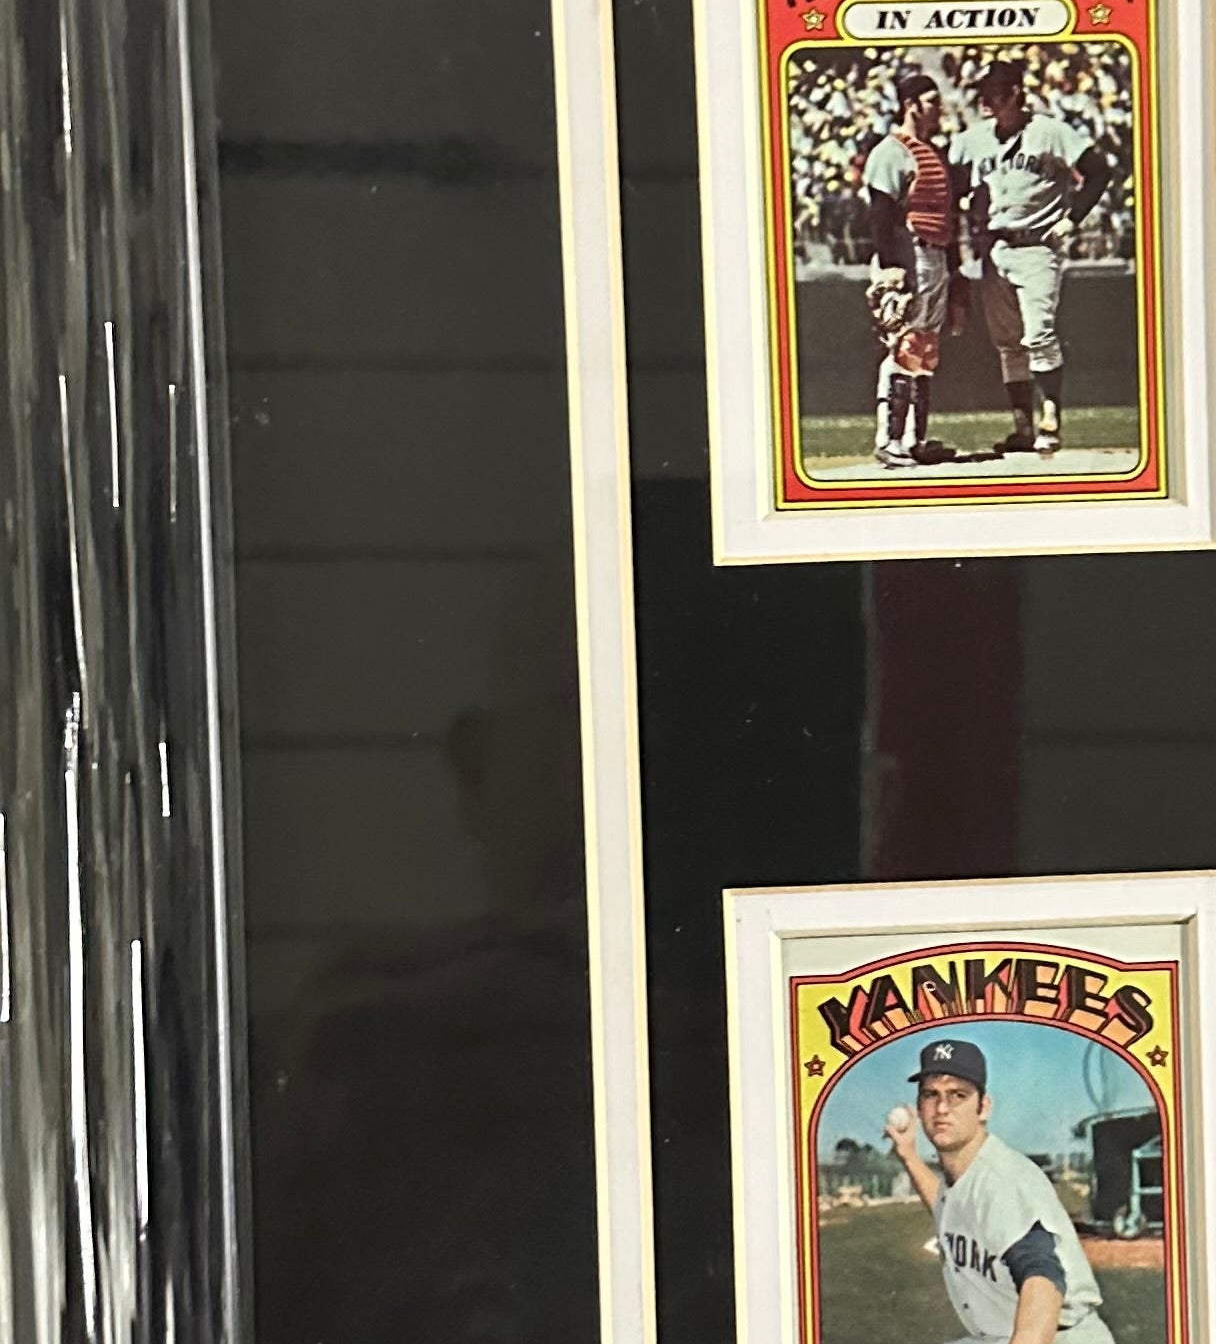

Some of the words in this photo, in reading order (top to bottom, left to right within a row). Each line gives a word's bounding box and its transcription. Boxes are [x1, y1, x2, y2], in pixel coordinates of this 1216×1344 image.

[876, 9, 911, 30] IN
[924, 7, 1039, 29] ACTION
[817, 958, 1155, 1057] YANKEES
